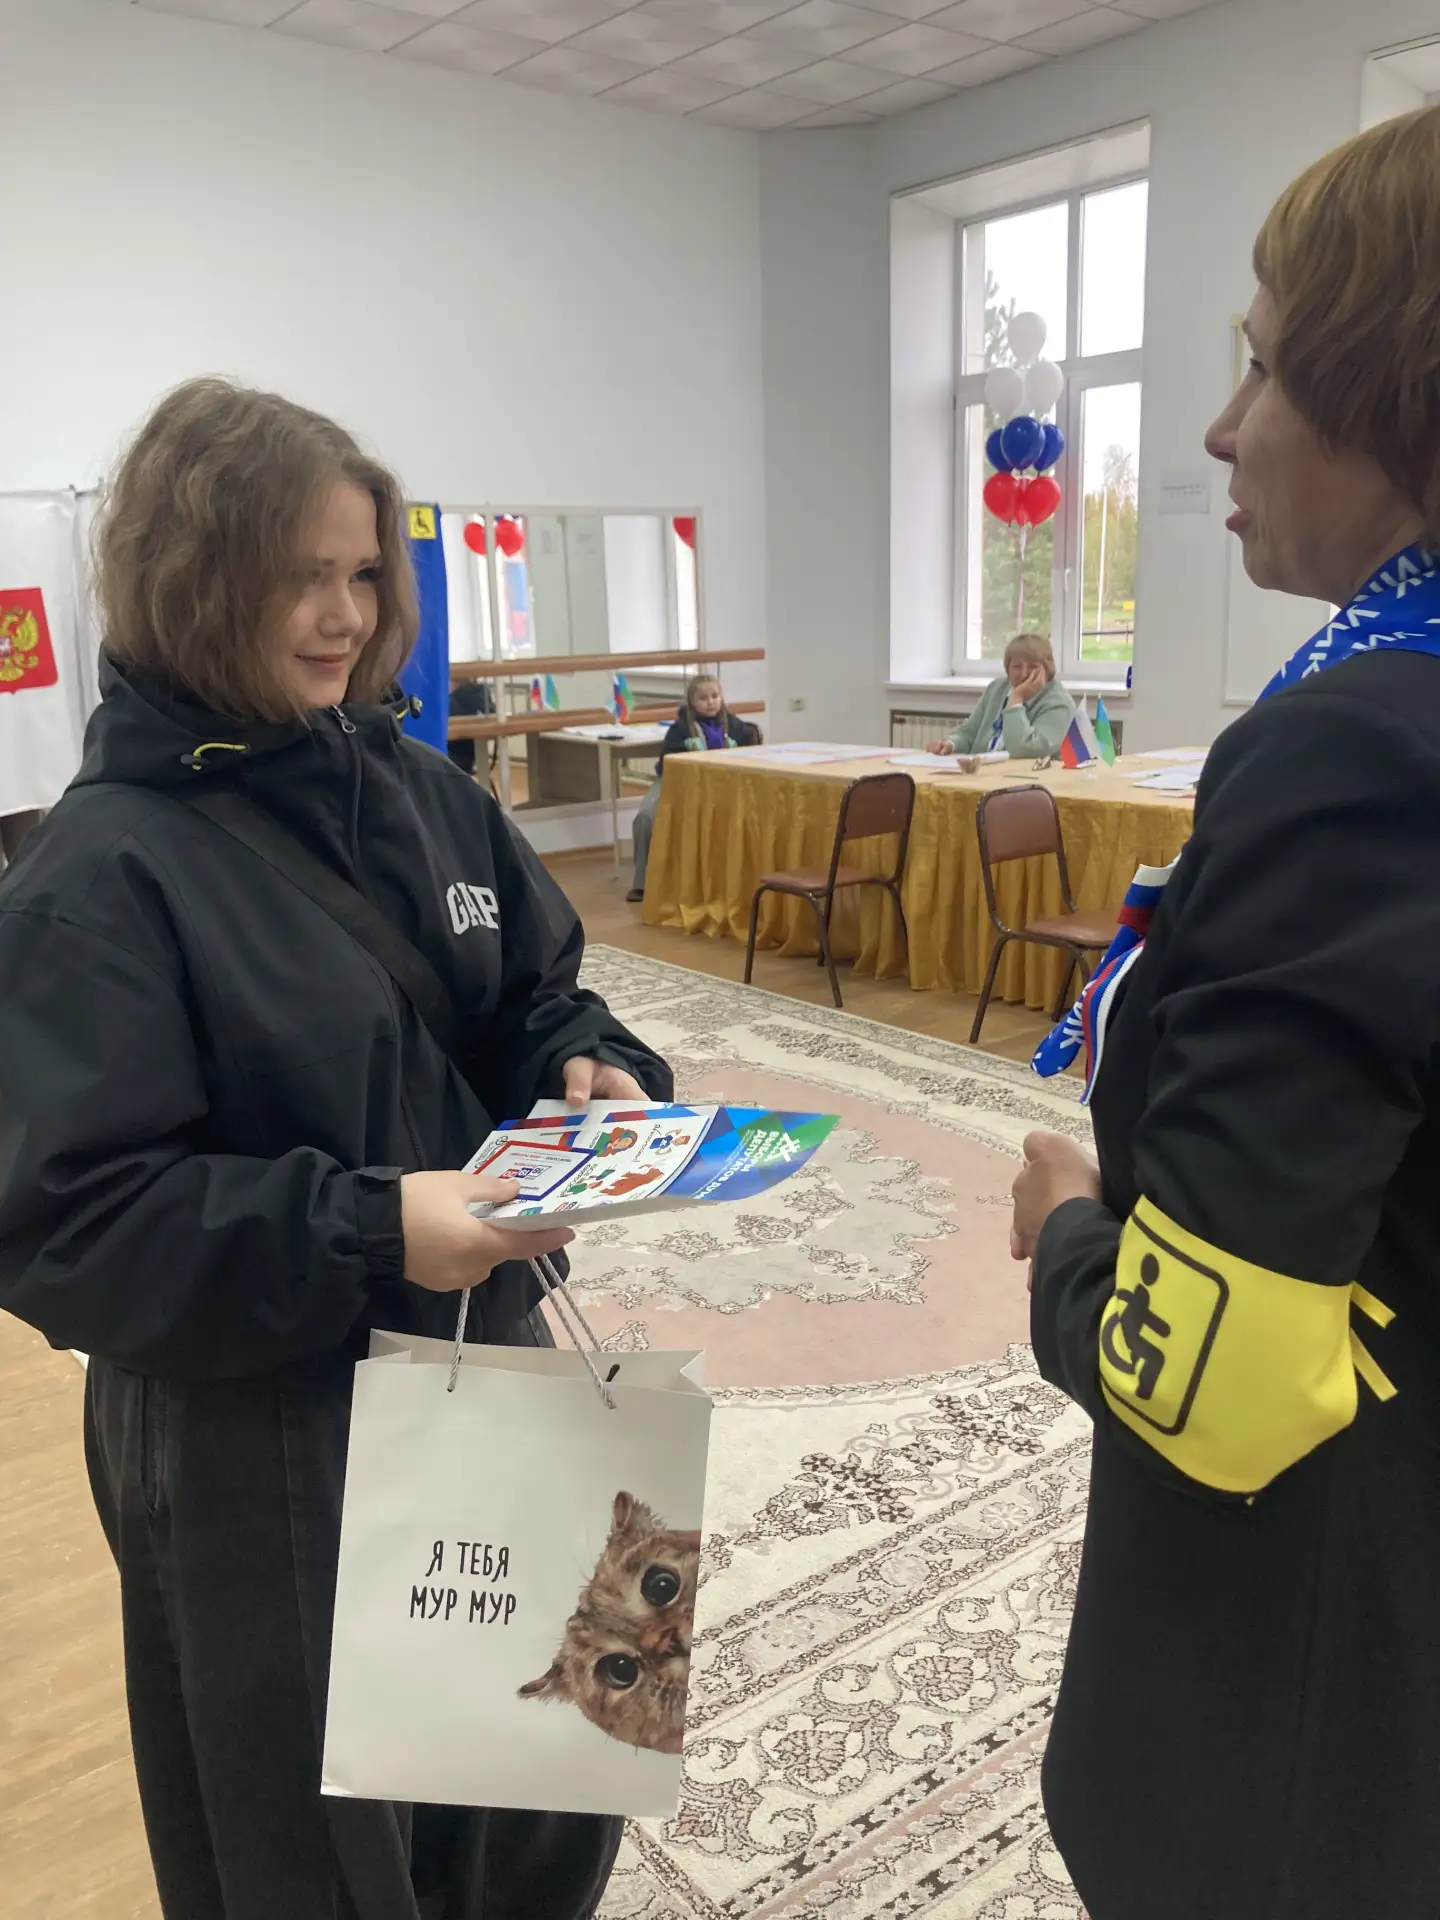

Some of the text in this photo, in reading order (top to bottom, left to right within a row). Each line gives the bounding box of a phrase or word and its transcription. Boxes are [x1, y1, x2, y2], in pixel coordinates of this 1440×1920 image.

[446, 882, 499, 935] GAP
[741, 1131, 780, 1172] ВЫБОРЫ
[425, 1540, 510, 1583] Я ТЕБЯ
[410, 1585, 517, 1625] МУР МУР
